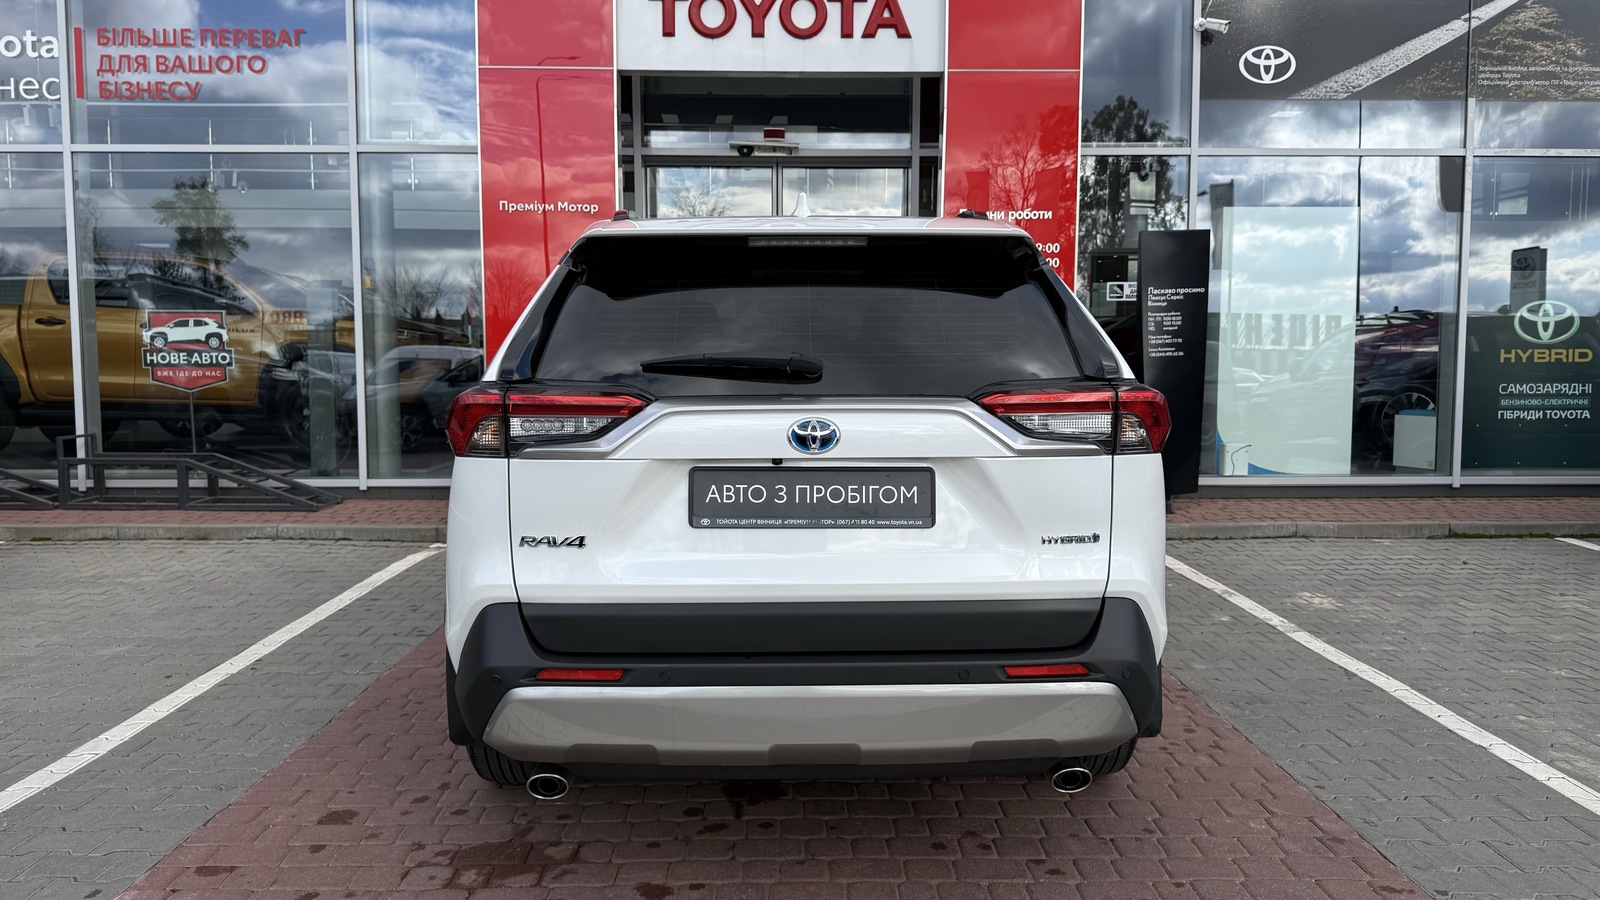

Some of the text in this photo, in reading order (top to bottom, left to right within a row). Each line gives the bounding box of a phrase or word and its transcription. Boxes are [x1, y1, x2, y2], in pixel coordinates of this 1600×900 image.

[647, 0, 912, 40] TOYOTA
[97, 27, 305, 47] БІЛЬШЕ ПЕРЕВАГ
[97, 55, 268, 76] ДЛЯ ВАШОГО
[98, 81, 200, 100] БІЗНЕСУ
[499, 200, 599, 215] Преміум Мотор
[1008, 208, 1053, 222] роботи
[1148, 286, 1205, 295] Ласкаво просимо
[146, 352, 230, 364] НОВЕ АВТО
[1500, 348, 1594, 363] HYBRID
[1499, 383, 1592, 395] САМОЗАРЯДНІ
[1497, 409, 1591, 421] ГІБРИДИ TOYOTA
[705, 484, 919, 505] АВТО З ПРОБІГОМ
[716, 517, 739, 526] ТОЙОТА
[738, 519, 757, 527] ЦЕНТР
[518, 535, 587, 549] RAV4
[1040, 535, 1092, 545] HYBRID
